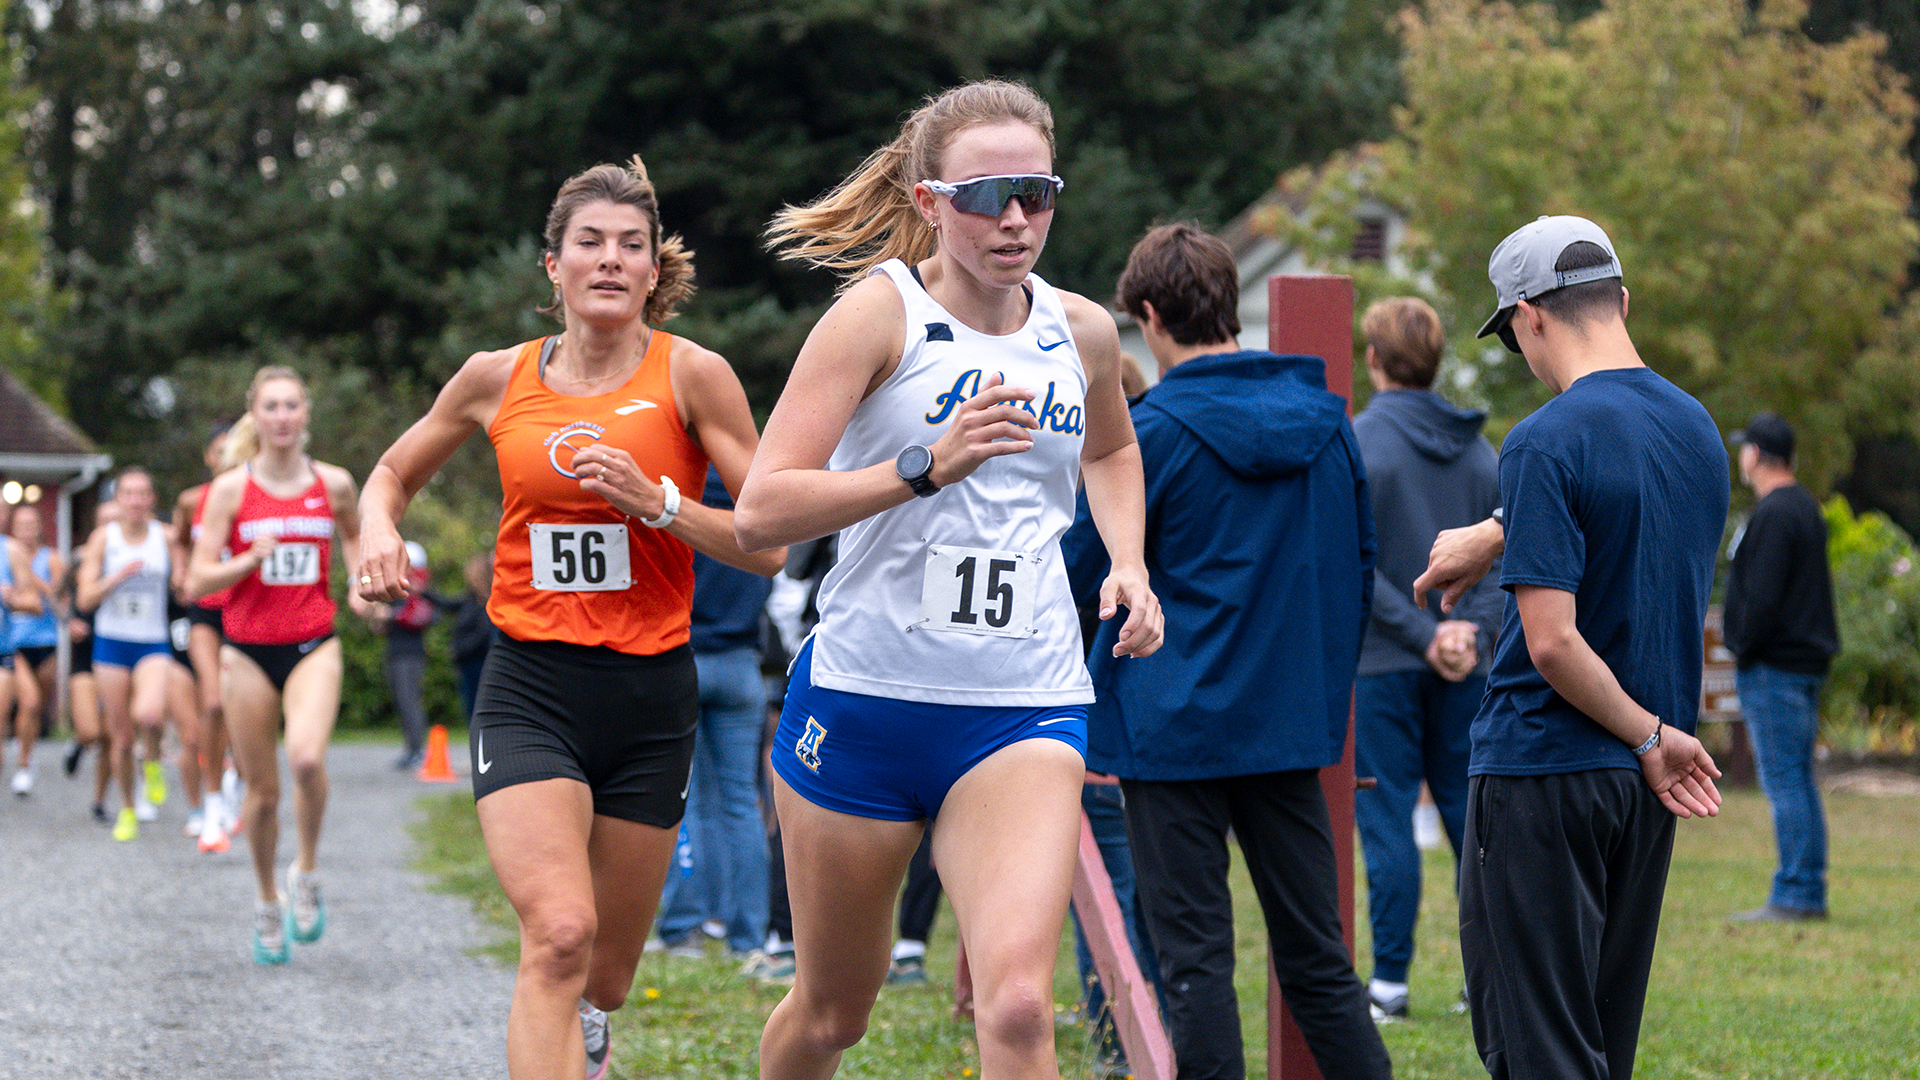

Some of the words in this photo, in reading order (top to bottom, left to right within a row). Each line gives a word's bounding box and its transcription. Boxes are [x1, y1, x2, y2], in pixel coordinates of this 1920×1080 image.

[924, 368, 1085, 436] Aka
[551, 530, 606, 584] 56
[950, 556, 1017, 628] 15
